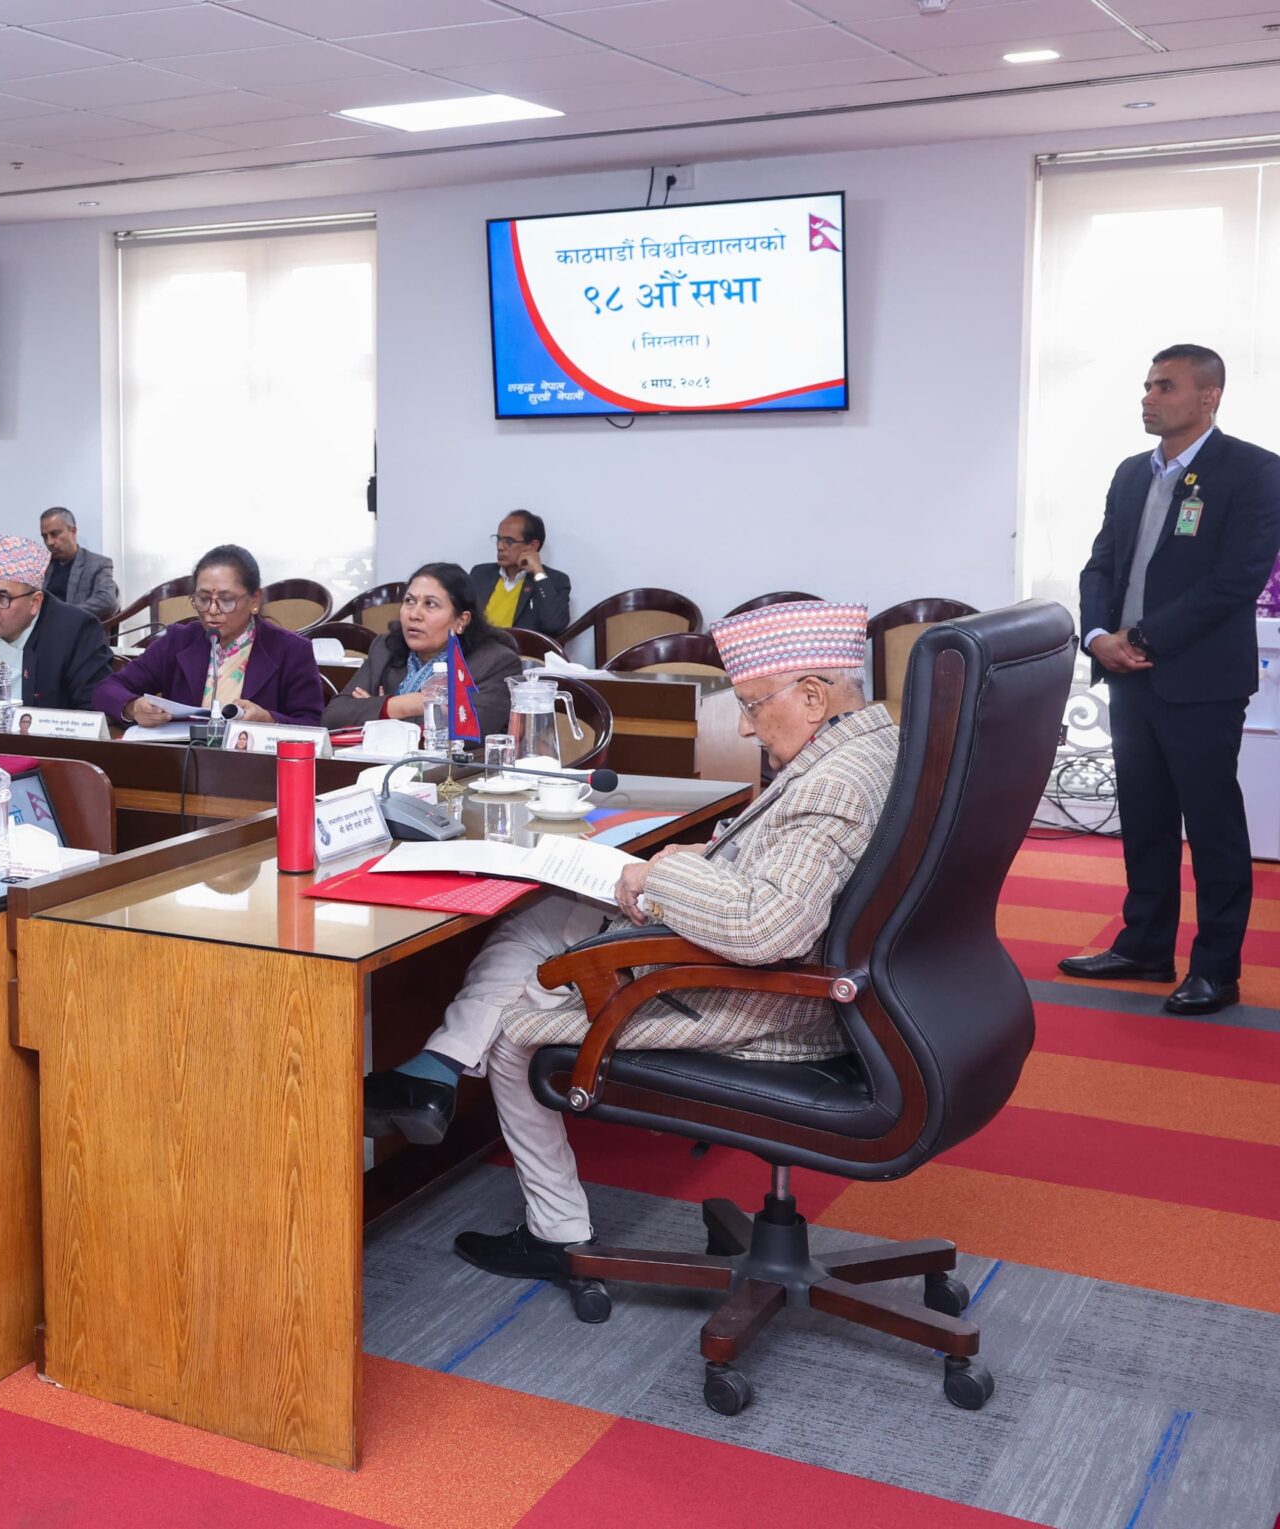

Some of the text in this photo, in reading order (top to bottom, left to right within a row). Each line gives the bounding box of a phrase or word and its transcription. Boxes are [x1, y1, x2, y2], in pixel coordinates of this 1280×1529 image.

[555, 228, 787, 265] काठमाडौं विश्वविद्यालयको
[583, 269, 762, 315] ९८ औँ सभा
[540, 379, 566, 391] नेपाल
[680, 375, 711, 390] २०८१
